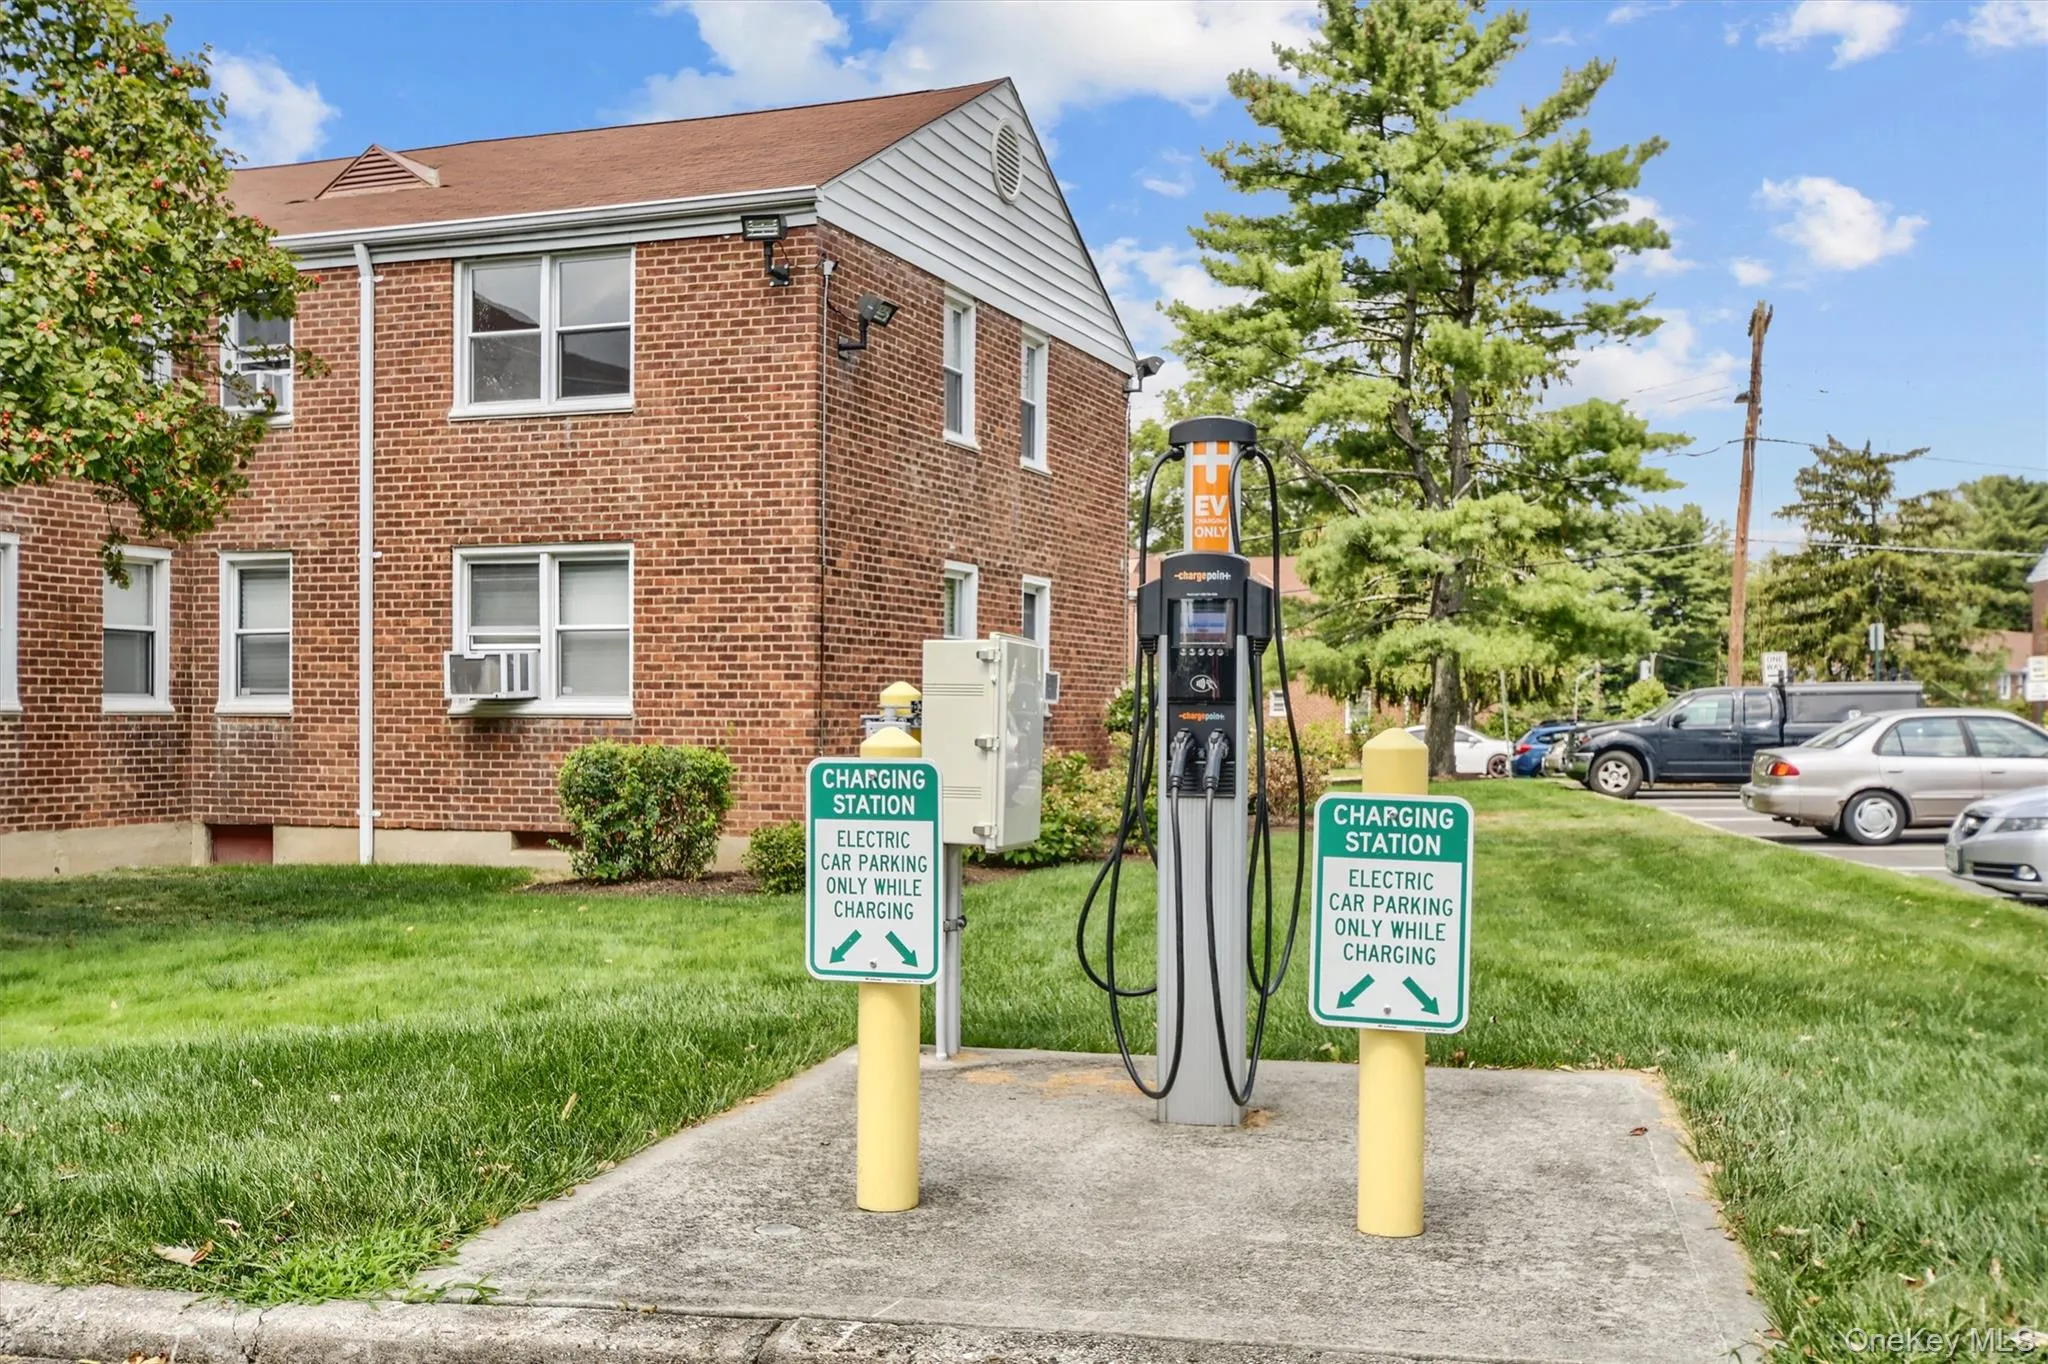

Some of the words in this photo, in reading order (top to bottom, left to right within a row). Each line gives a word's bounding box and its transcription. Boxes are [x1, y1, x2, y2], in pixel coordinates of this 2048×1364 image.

[1194, 495, 1228, 517] EV
[1194, 526, 1228, 539] ONLY
[1766, 663, 1784, 671] WAY
[822, 768, 926, 790] CHARGING
[833, 794, 915, 816] STATION
[1333, 804, 1454, 830] CHARGING
[837, 830, 910, 849] ELECTRIC
[1345, 831, 1441, 856] STATION
[821, 853, 851, 871] CAR
[859, 854, 928, 873] PARKING
[826, 876, 867, 895] ONLY
[874, 878, 922, 897] WHILE
[1349, 869, 1434, 891] ELECTRIC
[834, 900, 914, 920] CHARGING
[1329, 893, 1364, 912] CAR
[1373, 895, 1454, 917] PARKING
[1335, 918, 1383, 938] ONLY
[1391, 921, 1446, 942] WHILE
[1343, 943, 1436, 966] CHARGING
